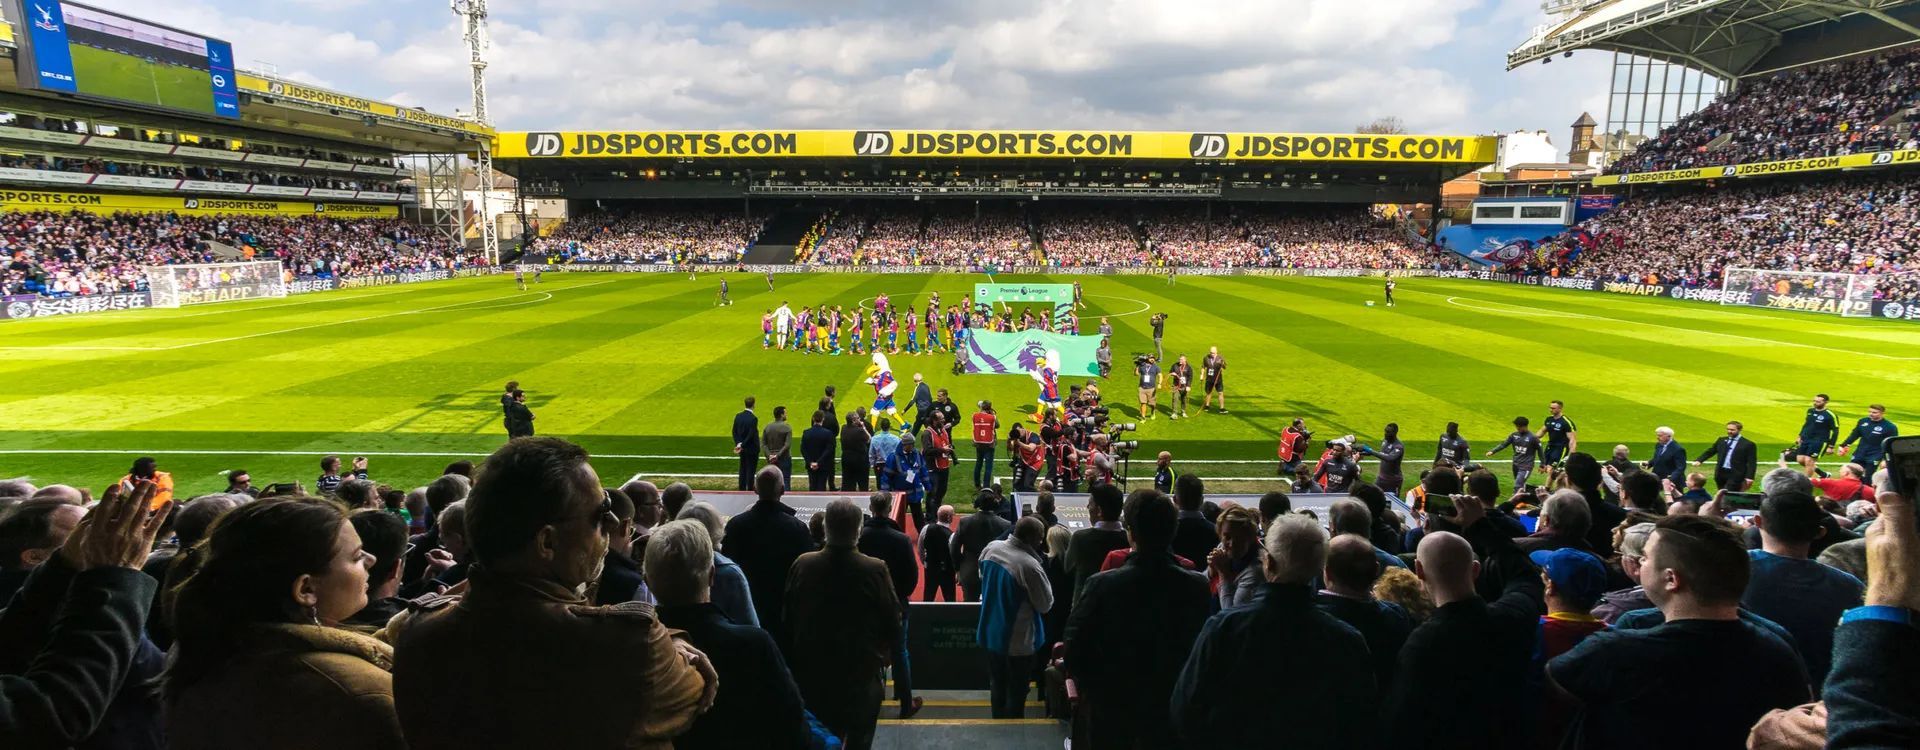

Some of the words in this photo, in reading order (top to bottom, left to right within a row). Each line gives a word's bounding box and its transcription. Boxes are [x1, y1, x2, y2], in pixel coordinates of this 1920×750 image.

[270, 82, 284, 94] JD
[287, 85, 371, 112] JDSPORTS.COM
[396, 108, 407, 119] JD
[407, 111, 466, 130] JDSPORTS.COM
[529, 133, 561, 155] JD
[570, 133, 797, 155] JDSPORTS.COM
[857, 132, 891, 155] JD
[899, 133, 1133, 155] JDSPORTS.COM
[1192, 134, 1226, 157] JD
[1235, 135, 1465, 160] JDSPORTS.COM
[1723, 165, 1736, 177] JD
[1738, 157, 1840, 174] JDSPORTS.COM
[1872, 152, 1892, 164] JD
[1896, 150, 1920, 162] JD
[1619, 174, 1629, 184] JD
[1629, 169, 1701, 182] JDSPORTS.COM
[185, 199, 199, 209] JD
[201, 200, 278, 210] JDSPORTS.COM
[315, 203, 324, 211] JD
[326, 204, 380, 213] JDSPORTS.COM
